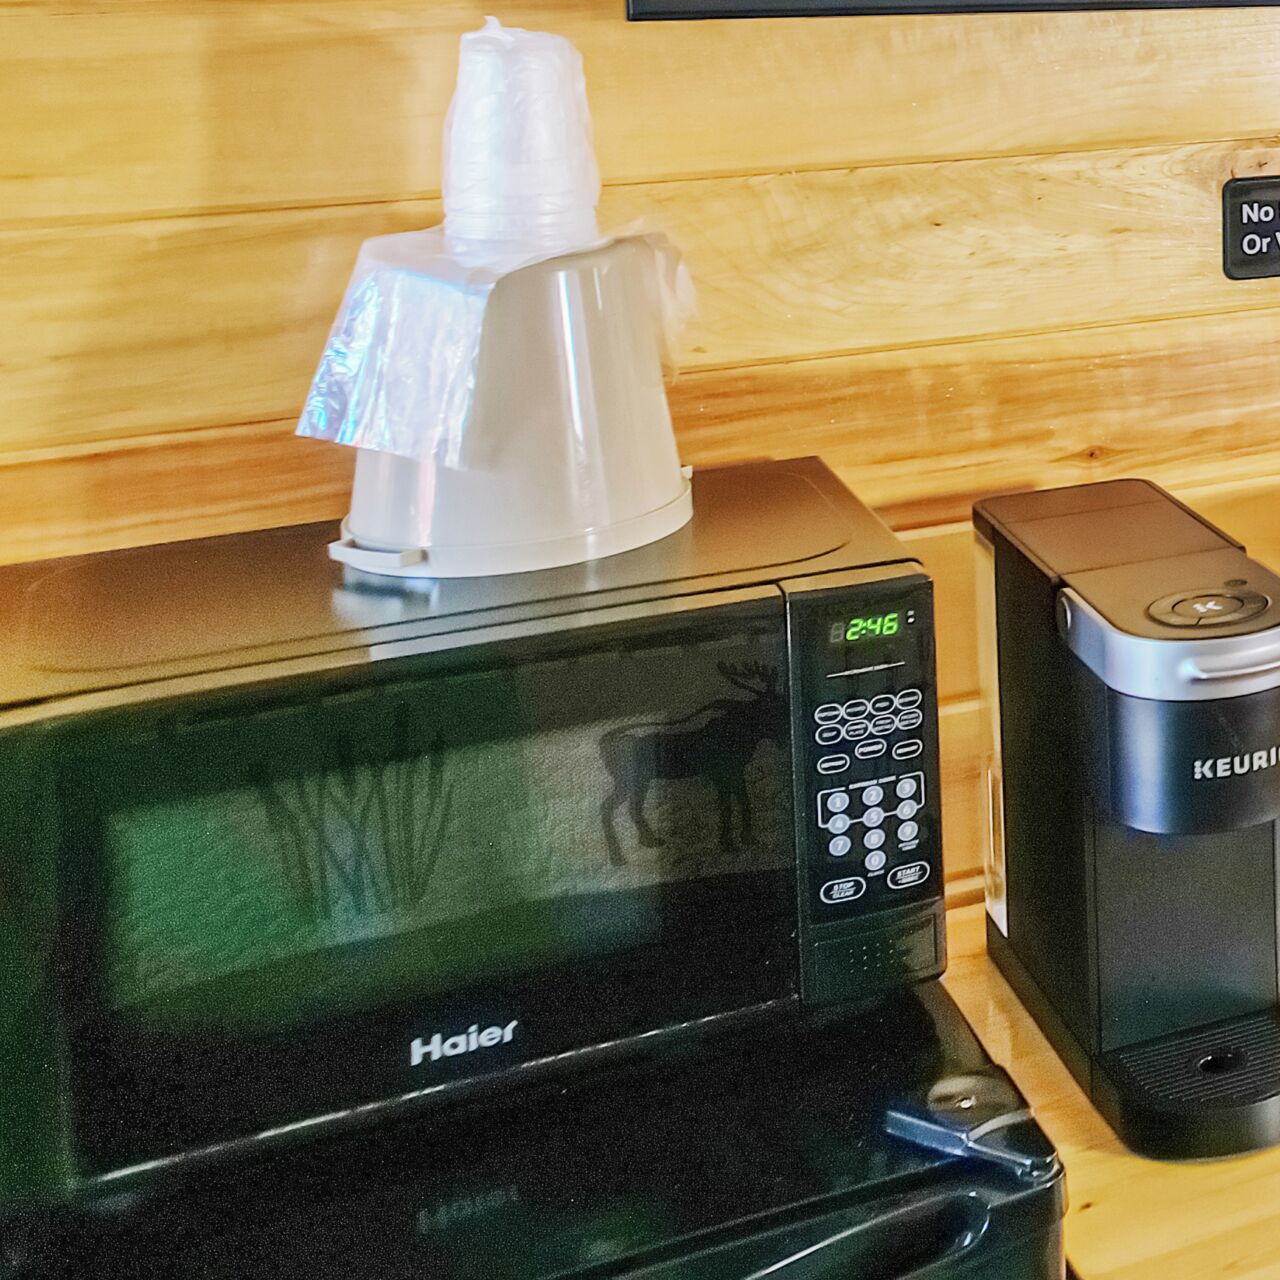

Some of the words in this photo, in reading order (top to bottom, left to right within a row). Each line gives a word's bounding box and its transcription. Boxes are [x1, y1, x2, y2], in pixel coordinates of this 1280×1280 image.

[1241, 202, 1275, 224] No
[1242, 233, 1272, 255] Or
[846, 613, 899, 641] 2:46
[833, 880, 855, 892] STOP
[410, 1019, 519, 1066] Haier
